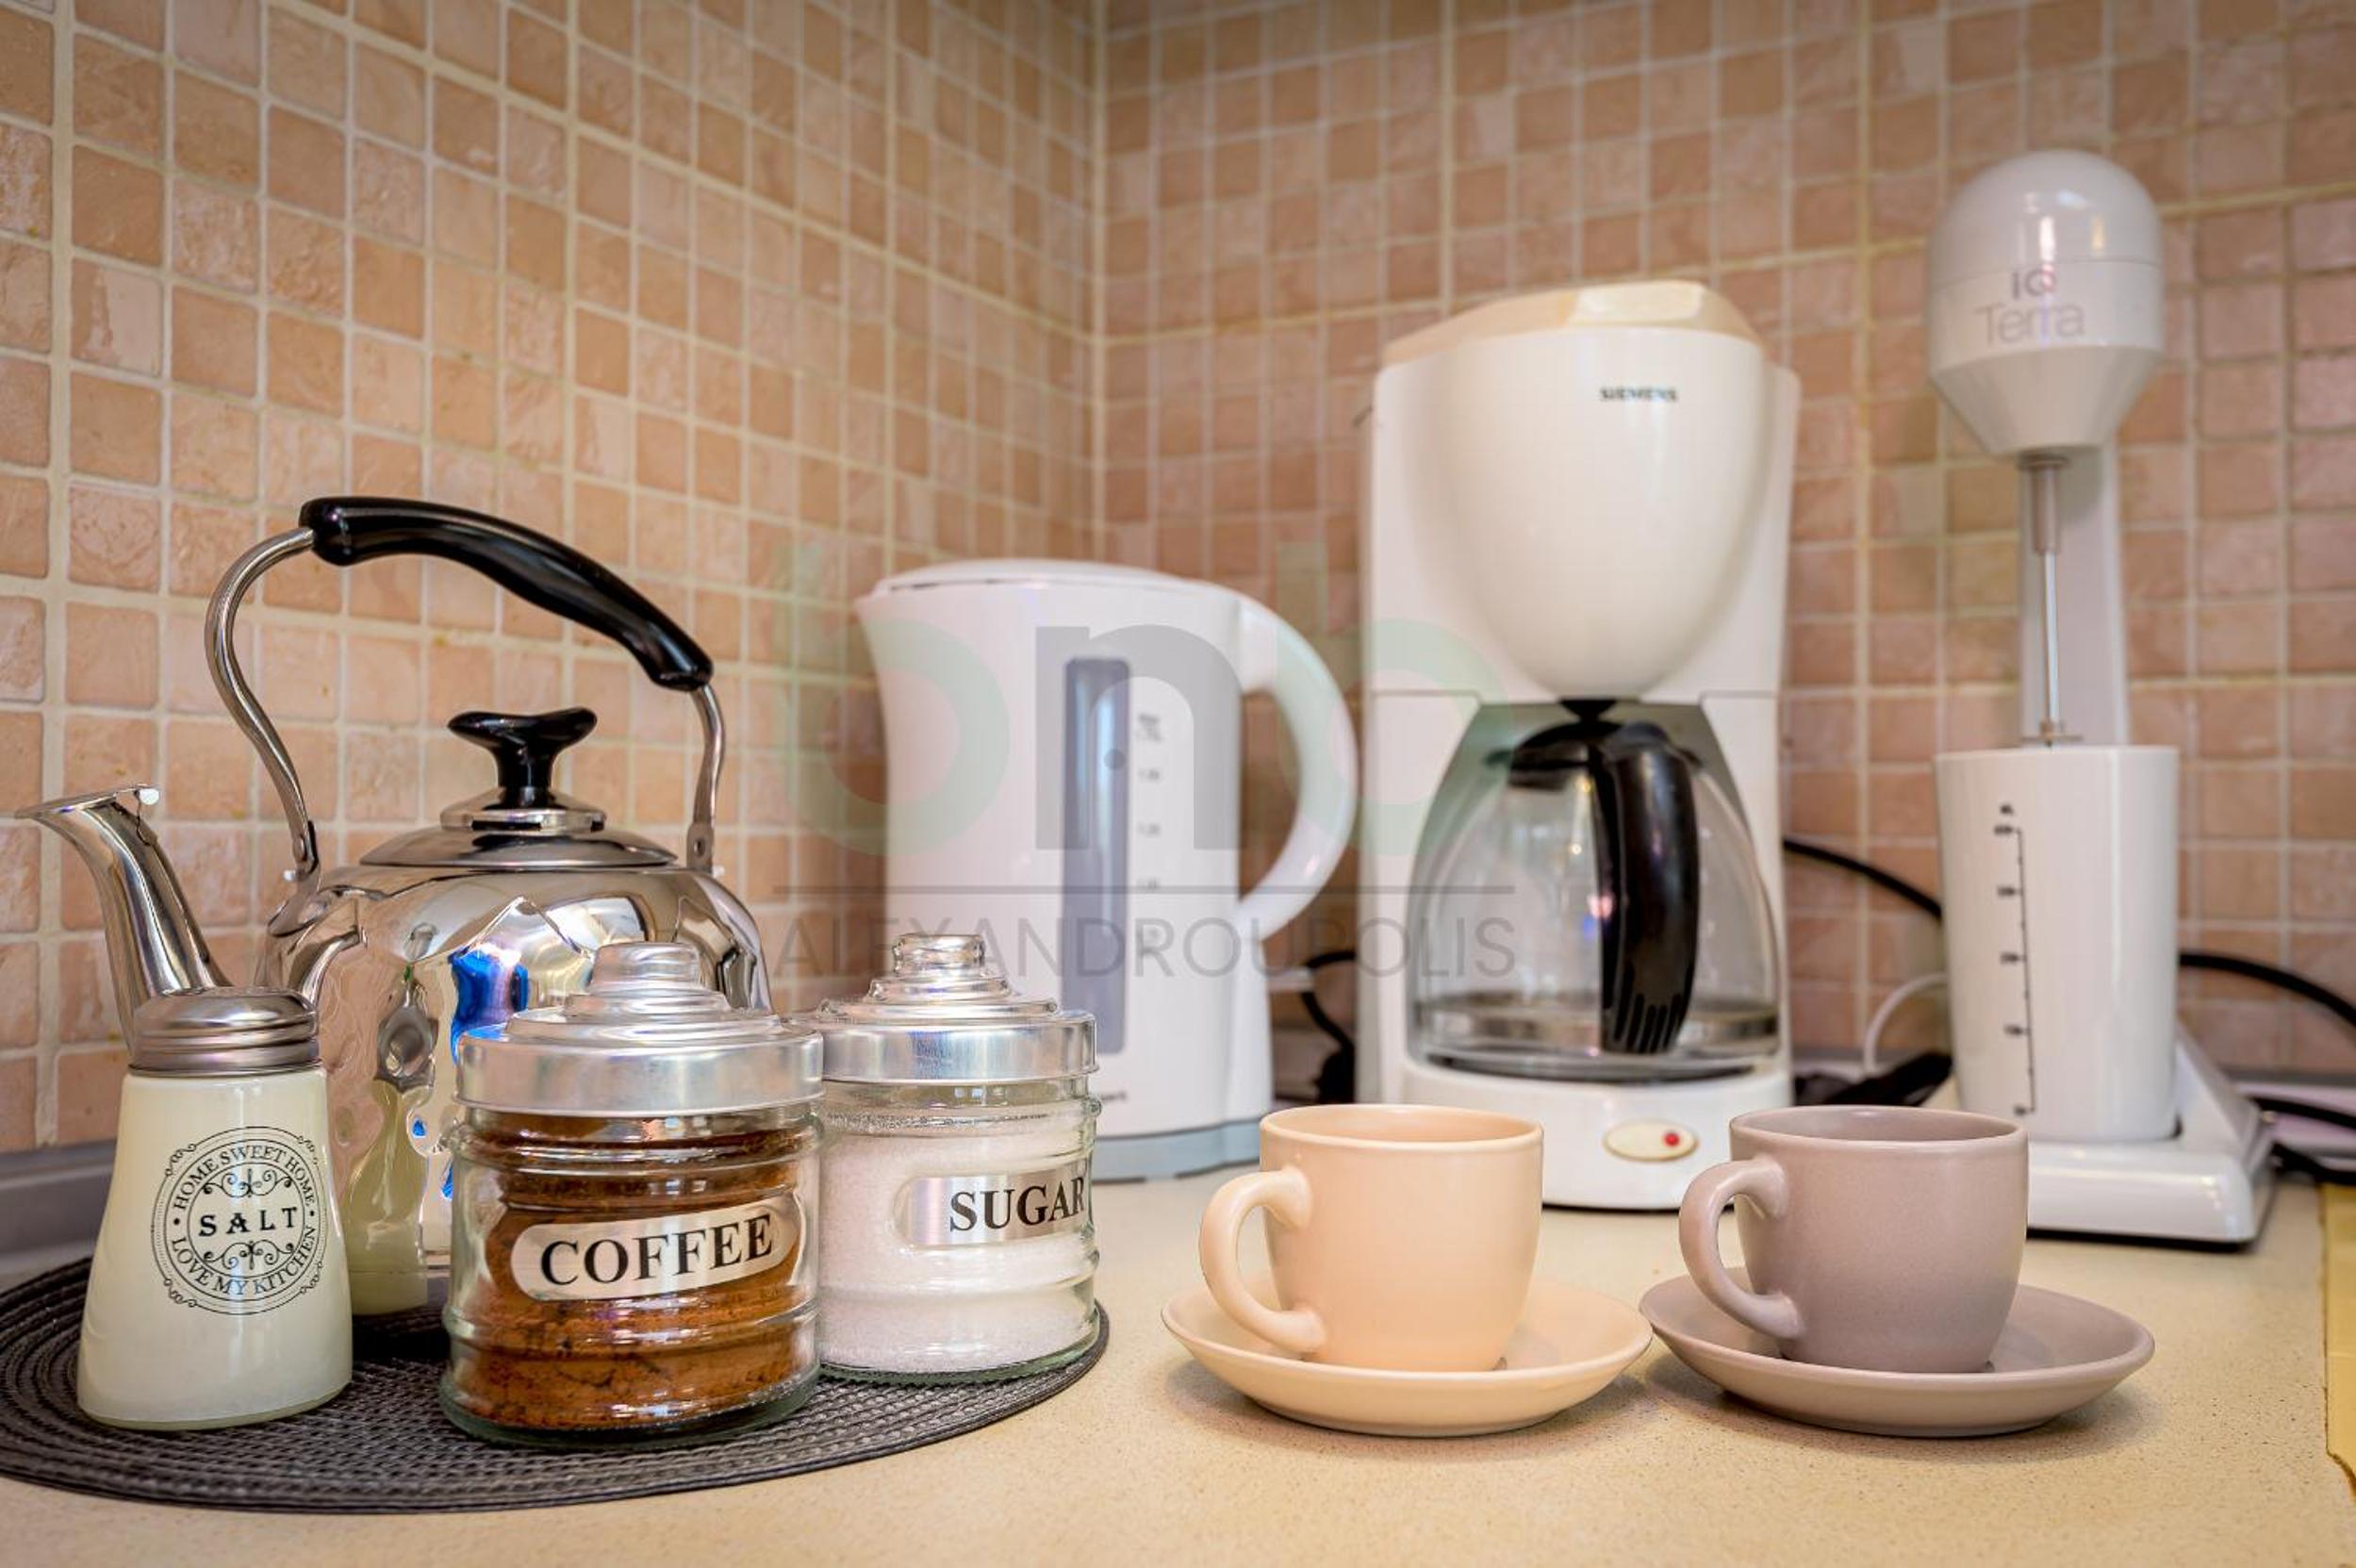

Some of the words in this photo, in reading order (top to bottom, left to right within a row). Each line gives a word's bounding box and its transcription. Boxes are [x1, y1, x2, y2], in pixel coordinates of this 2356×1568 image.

[173, 1159, 219, 1211] HOME
[221, 1145, 287, 1165] SWEET
[285, 1157, 315, 1207] HOME
[949, 1176, 1085, 1232] SUGAR
[198, 1206, 298, 1237] SALT
[539, 1213, 774, 1286] COFFEE
[172, 1236, 209, 1286] LOVE
[214, 1278, 248, 1296] MY
[252, 1225, 317, 1296] KITCHEN
